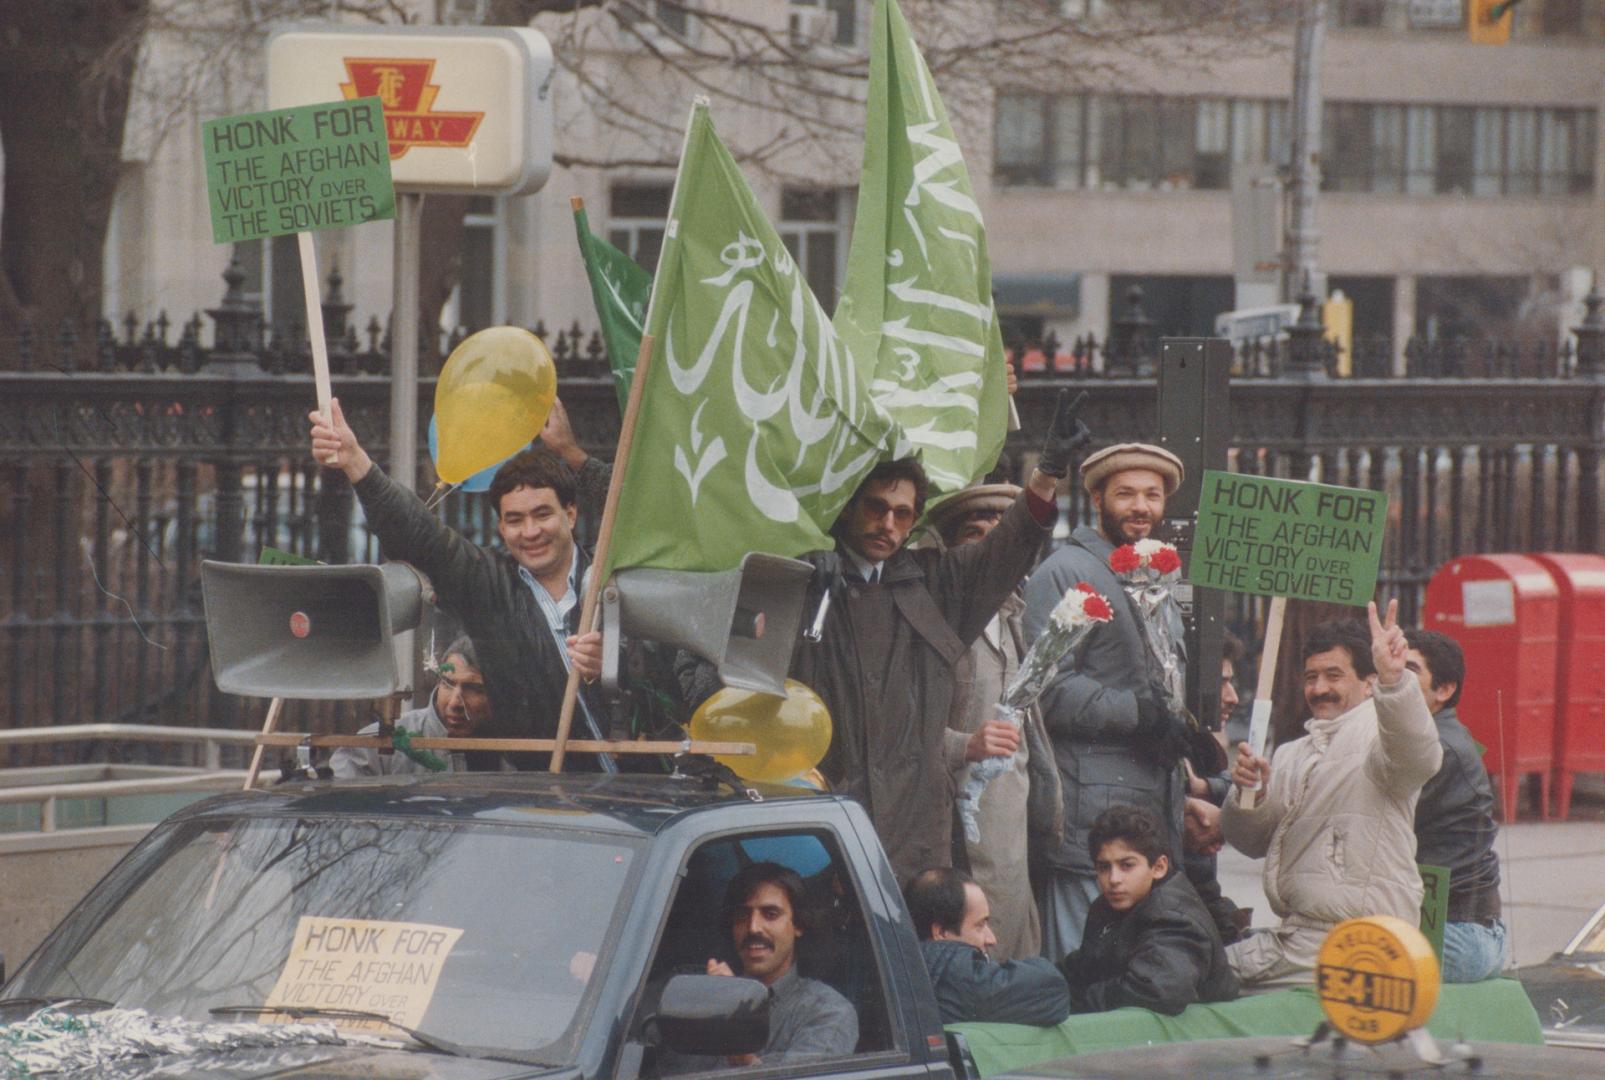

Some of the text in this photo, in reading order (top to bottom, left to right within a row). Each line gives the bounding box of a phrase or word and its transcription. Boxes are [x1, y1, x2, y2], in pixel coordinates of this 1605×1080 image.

[213, 105, 374, 153] HONK FOR
[216, 141, 381, 184] THE AFGHAN
[218, 176, 367, 212] VICTORY OVER
[222, 195, 377, 237] THE SOVIETS
[1214, 479, 1376, 524] HONK FOR
[1211, 512, 1372, 553] THE AFGHAN
[1205, 536, 1350, 575] VICTORY OVER
[1203, 561, 1354, 600] THE SOVIETS
[305, 925, 447, 955] HONK FOR
[296, 959, 433, 985] THE AFGHAN
[282, 982, 409, 1009] VICTORY OVER
